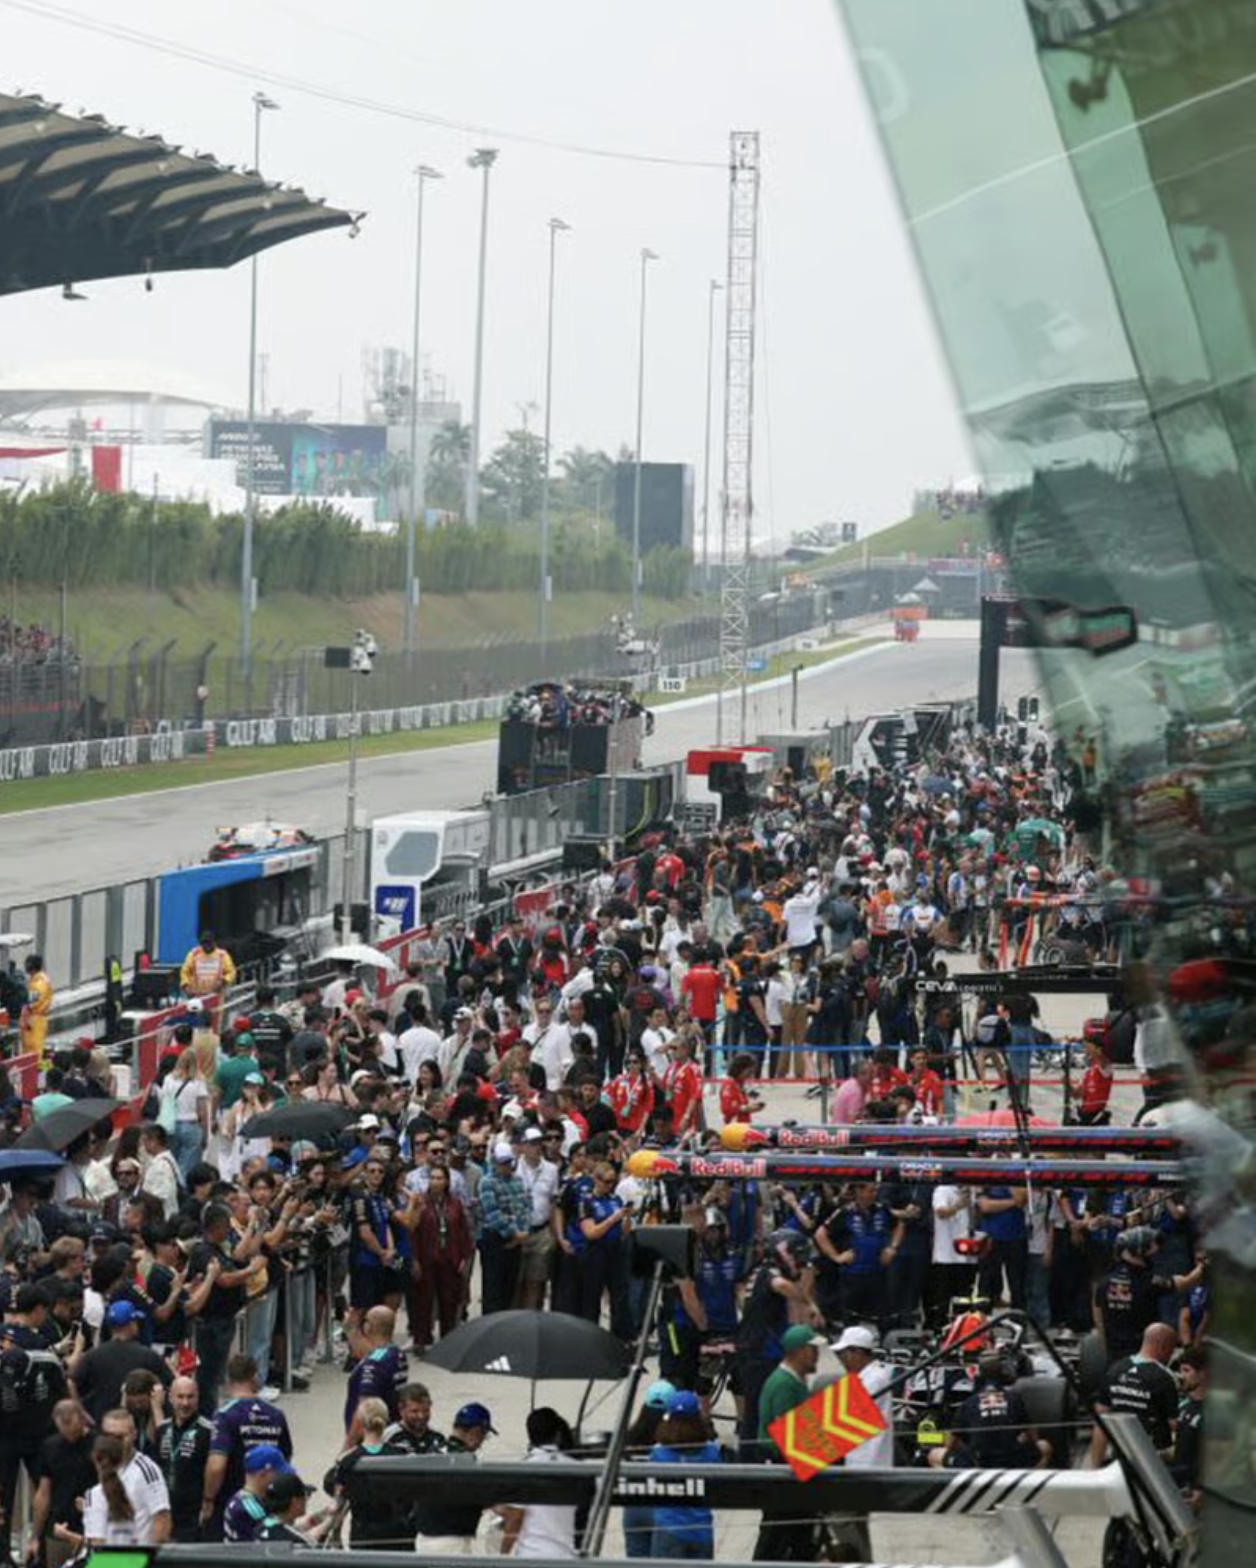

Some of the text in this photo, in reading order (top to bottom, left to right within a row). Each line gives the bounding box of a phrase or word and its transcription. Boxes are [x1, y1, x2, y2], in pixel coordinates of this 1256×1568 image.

[663, 680, 682, 691] 150
[226, 720, 254, 747] GULF
[257, 718, 276, 745] AIR
[18, 748, 34, 779] AIR
[49, 741, 88, 774] GULF AIR
[915, 980, 958, 992] CEVA
[779, 1128, 812, 1146] Red
[813, 1128, 850, 1147] Bull
[691, 1156, 726, 1176] Red
[727, 1157, 766, 1177] Bull
